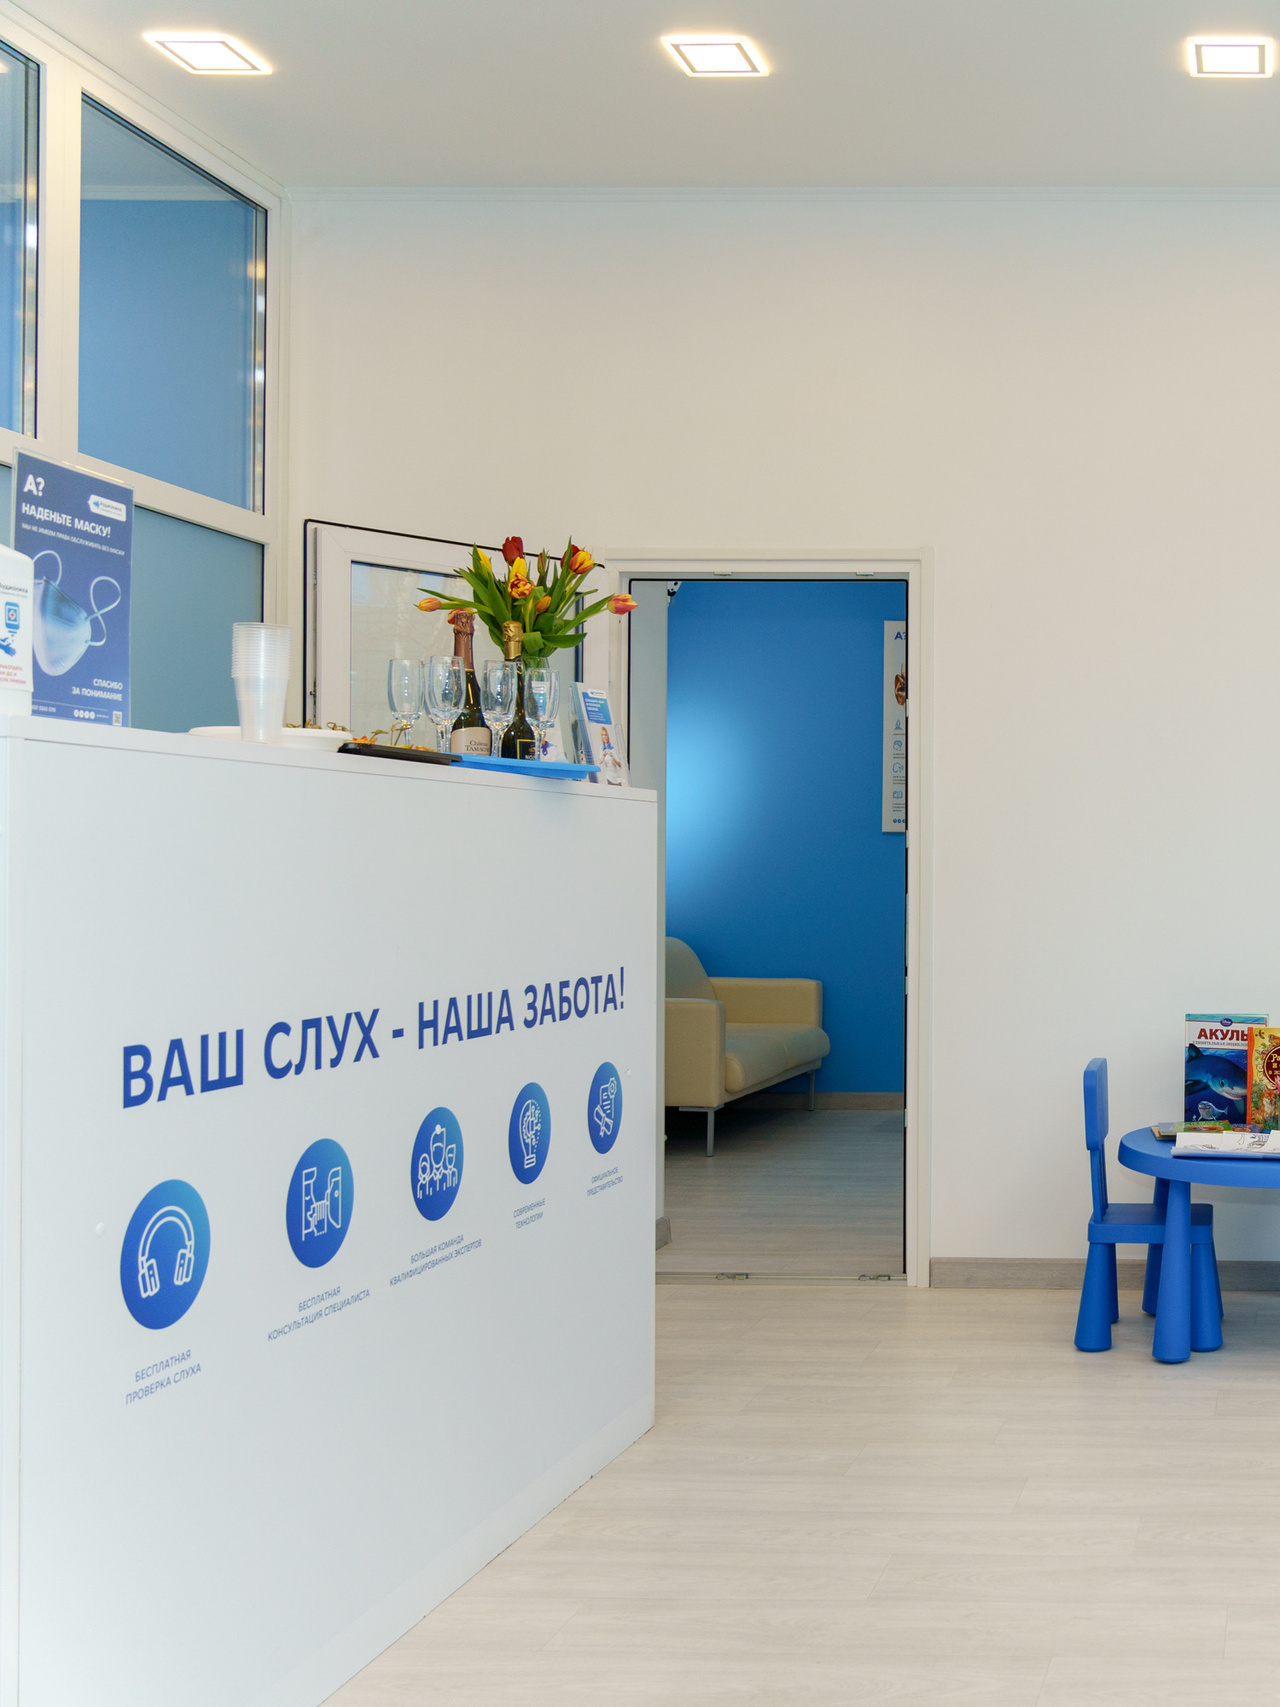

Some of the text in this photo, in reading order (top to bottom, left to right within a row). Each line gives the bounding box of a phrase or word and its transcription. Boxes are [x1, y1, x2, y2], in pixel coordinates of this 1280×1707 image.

[23, 474, 45, 497] А?
[22, 502, 111, 538] НАДЕНЬТЕ МАСКУ!
[72, 686, 122, 701] ЗА ПОНИМАНИЕ
[93, 678, 123, 690] СПАСИБО
[123, 966, 624, 1109] ВАШ СЛУХ - НАША ЗАБОТА!
[513, 1198, 546, 1218] СОВРЕМЕННЫЕ
[516, 1211, 544, 1229] ТЕХНОЛОГИИ
[389, 1238, 482, 1286] КВАЛИФИЦИРОВАННЫХ ЭКСПЕРТОВ
[410, 1234, 464, 1264] БОЛЬШАЯ КОМАНДА
[298, 1286, 341, 1313] БЕСПЛАТНАЯ
[267, 1289, 371, 1342] КОНСУЛЬТАЦИЯ СПЕЦИАЛИСТА
[135, 1349, 191, 1383] БЕСПЛАТНАЯ
[125, 1362, 202, 1405] ПРОВЕРКА СЛУХА
